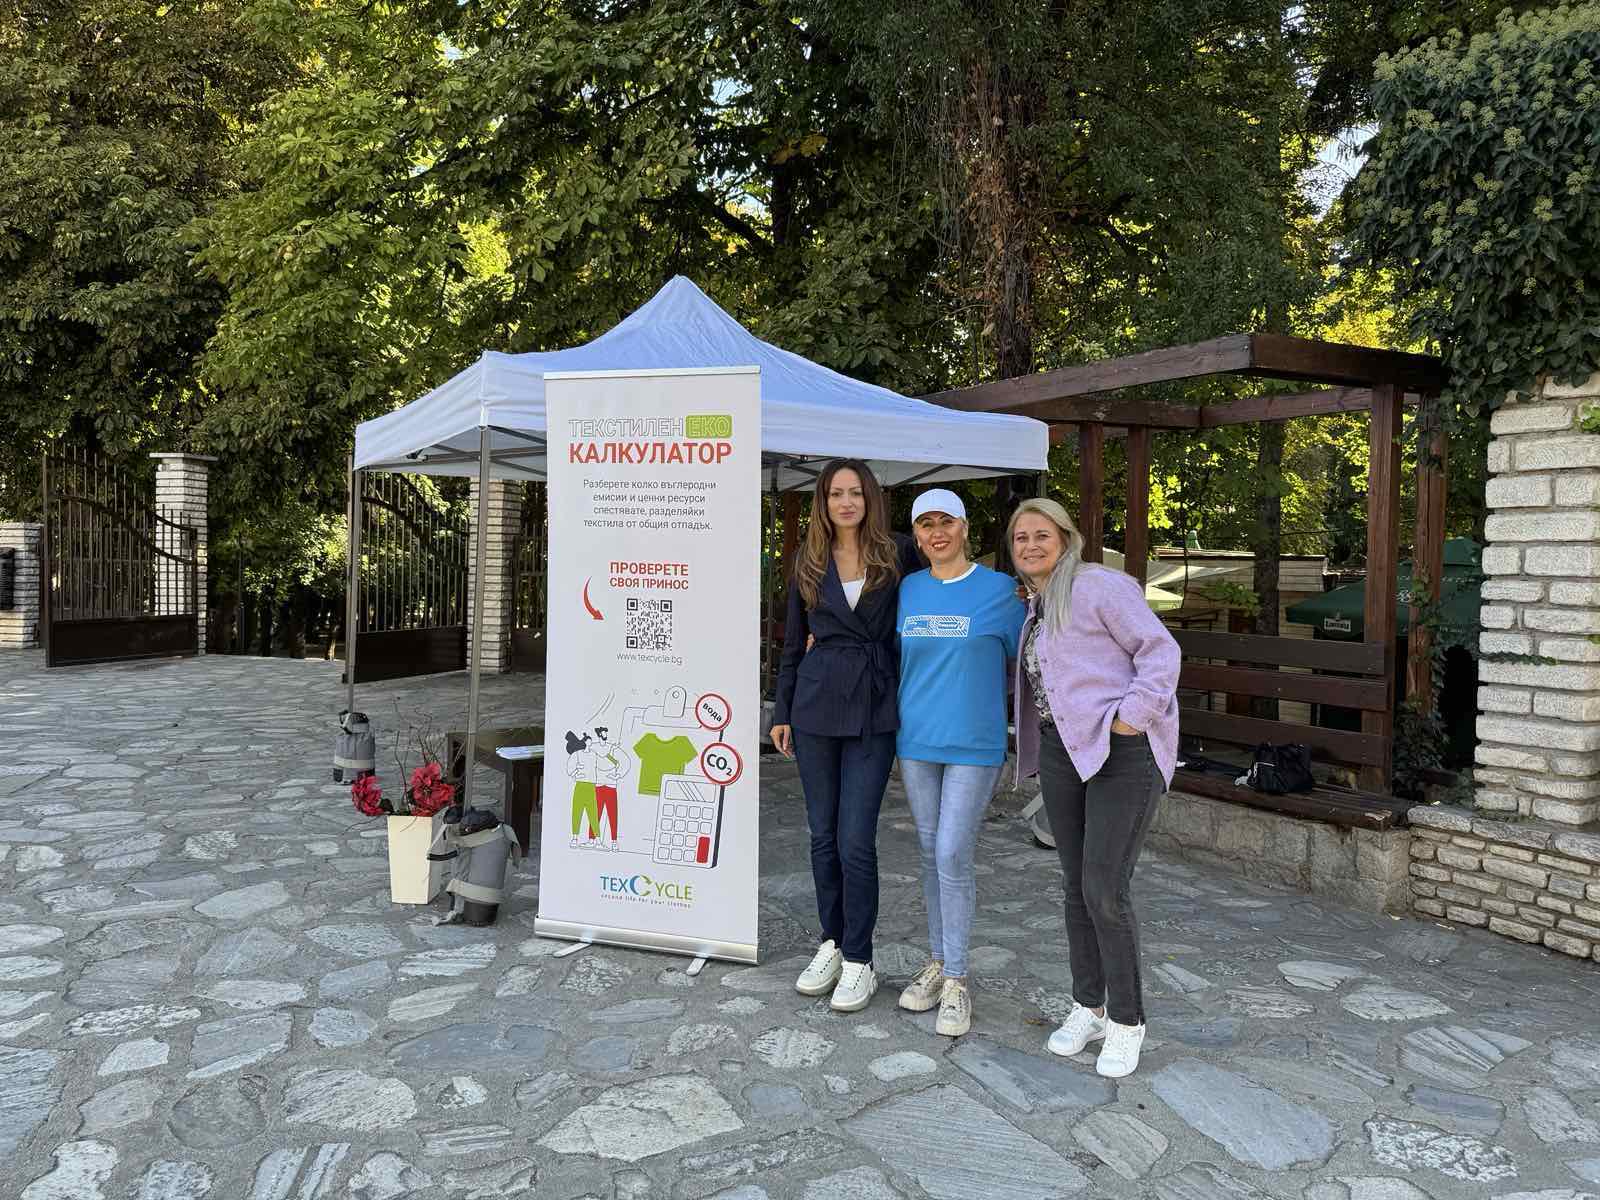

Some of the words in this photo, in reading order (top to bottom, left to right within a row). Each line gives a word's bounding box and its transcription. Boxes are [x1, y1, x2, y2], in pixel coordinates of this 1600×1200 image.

[568, 418, 684, 438] ТЕКСТИЛЕН
[688, 416, 730, 437] ЕКО
[569, 442, 732, 464] КАЛКУЛАТОР
[584, 480, 630, 490] Разберете
[631, 480, 659, 489] колко
[661, 480, 716, 490] въглеродни
[593, 494, 627, 502] емисии
[638, 494, 665, 504] ценни
[668, 495, 705, 504] ресурси
[594, 508, 647, 516] спестявате,
[649, 506, 704, 517] разделяйки
[584, 520, 624, 528] текстила
[638, 519, 668, 530] общия
[671, 520, 712, 530] отпадък.
[610, 562, 688, 576] ПРОВЕРЕТЕ
[610, 577, 639, 588] СВОЯ
[642, 578, 688, 590] ПРИНОС
